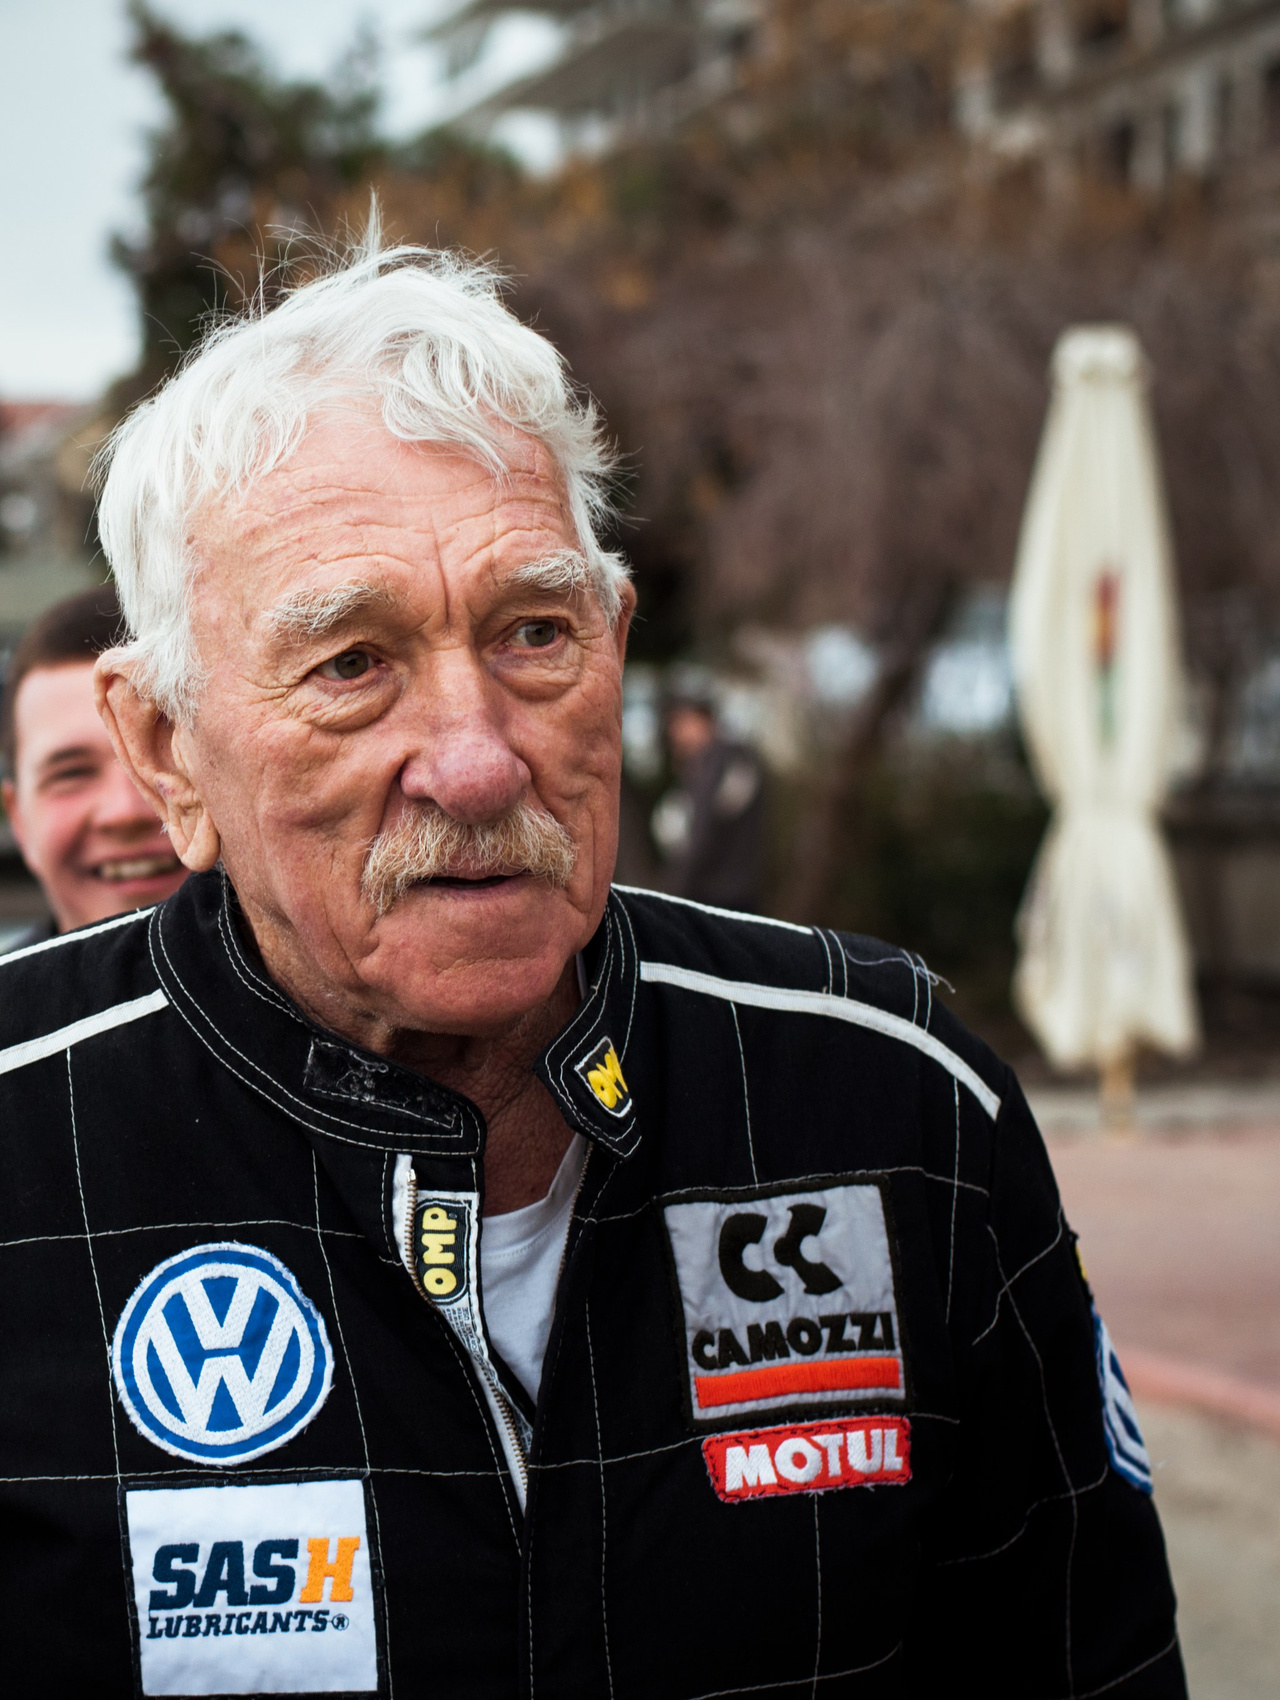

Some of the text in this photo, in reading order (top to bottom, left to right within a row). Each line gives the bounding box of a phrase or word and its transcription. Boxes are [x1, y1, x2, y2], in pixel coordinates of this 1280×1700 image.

[421, 1206, 457, 1295] OMP
[691, 1311, 897, 1371] CAMOZZI
[725, 1428, 904, 1493] MOTUL
[147, 1535, 361, 1611] SASH
